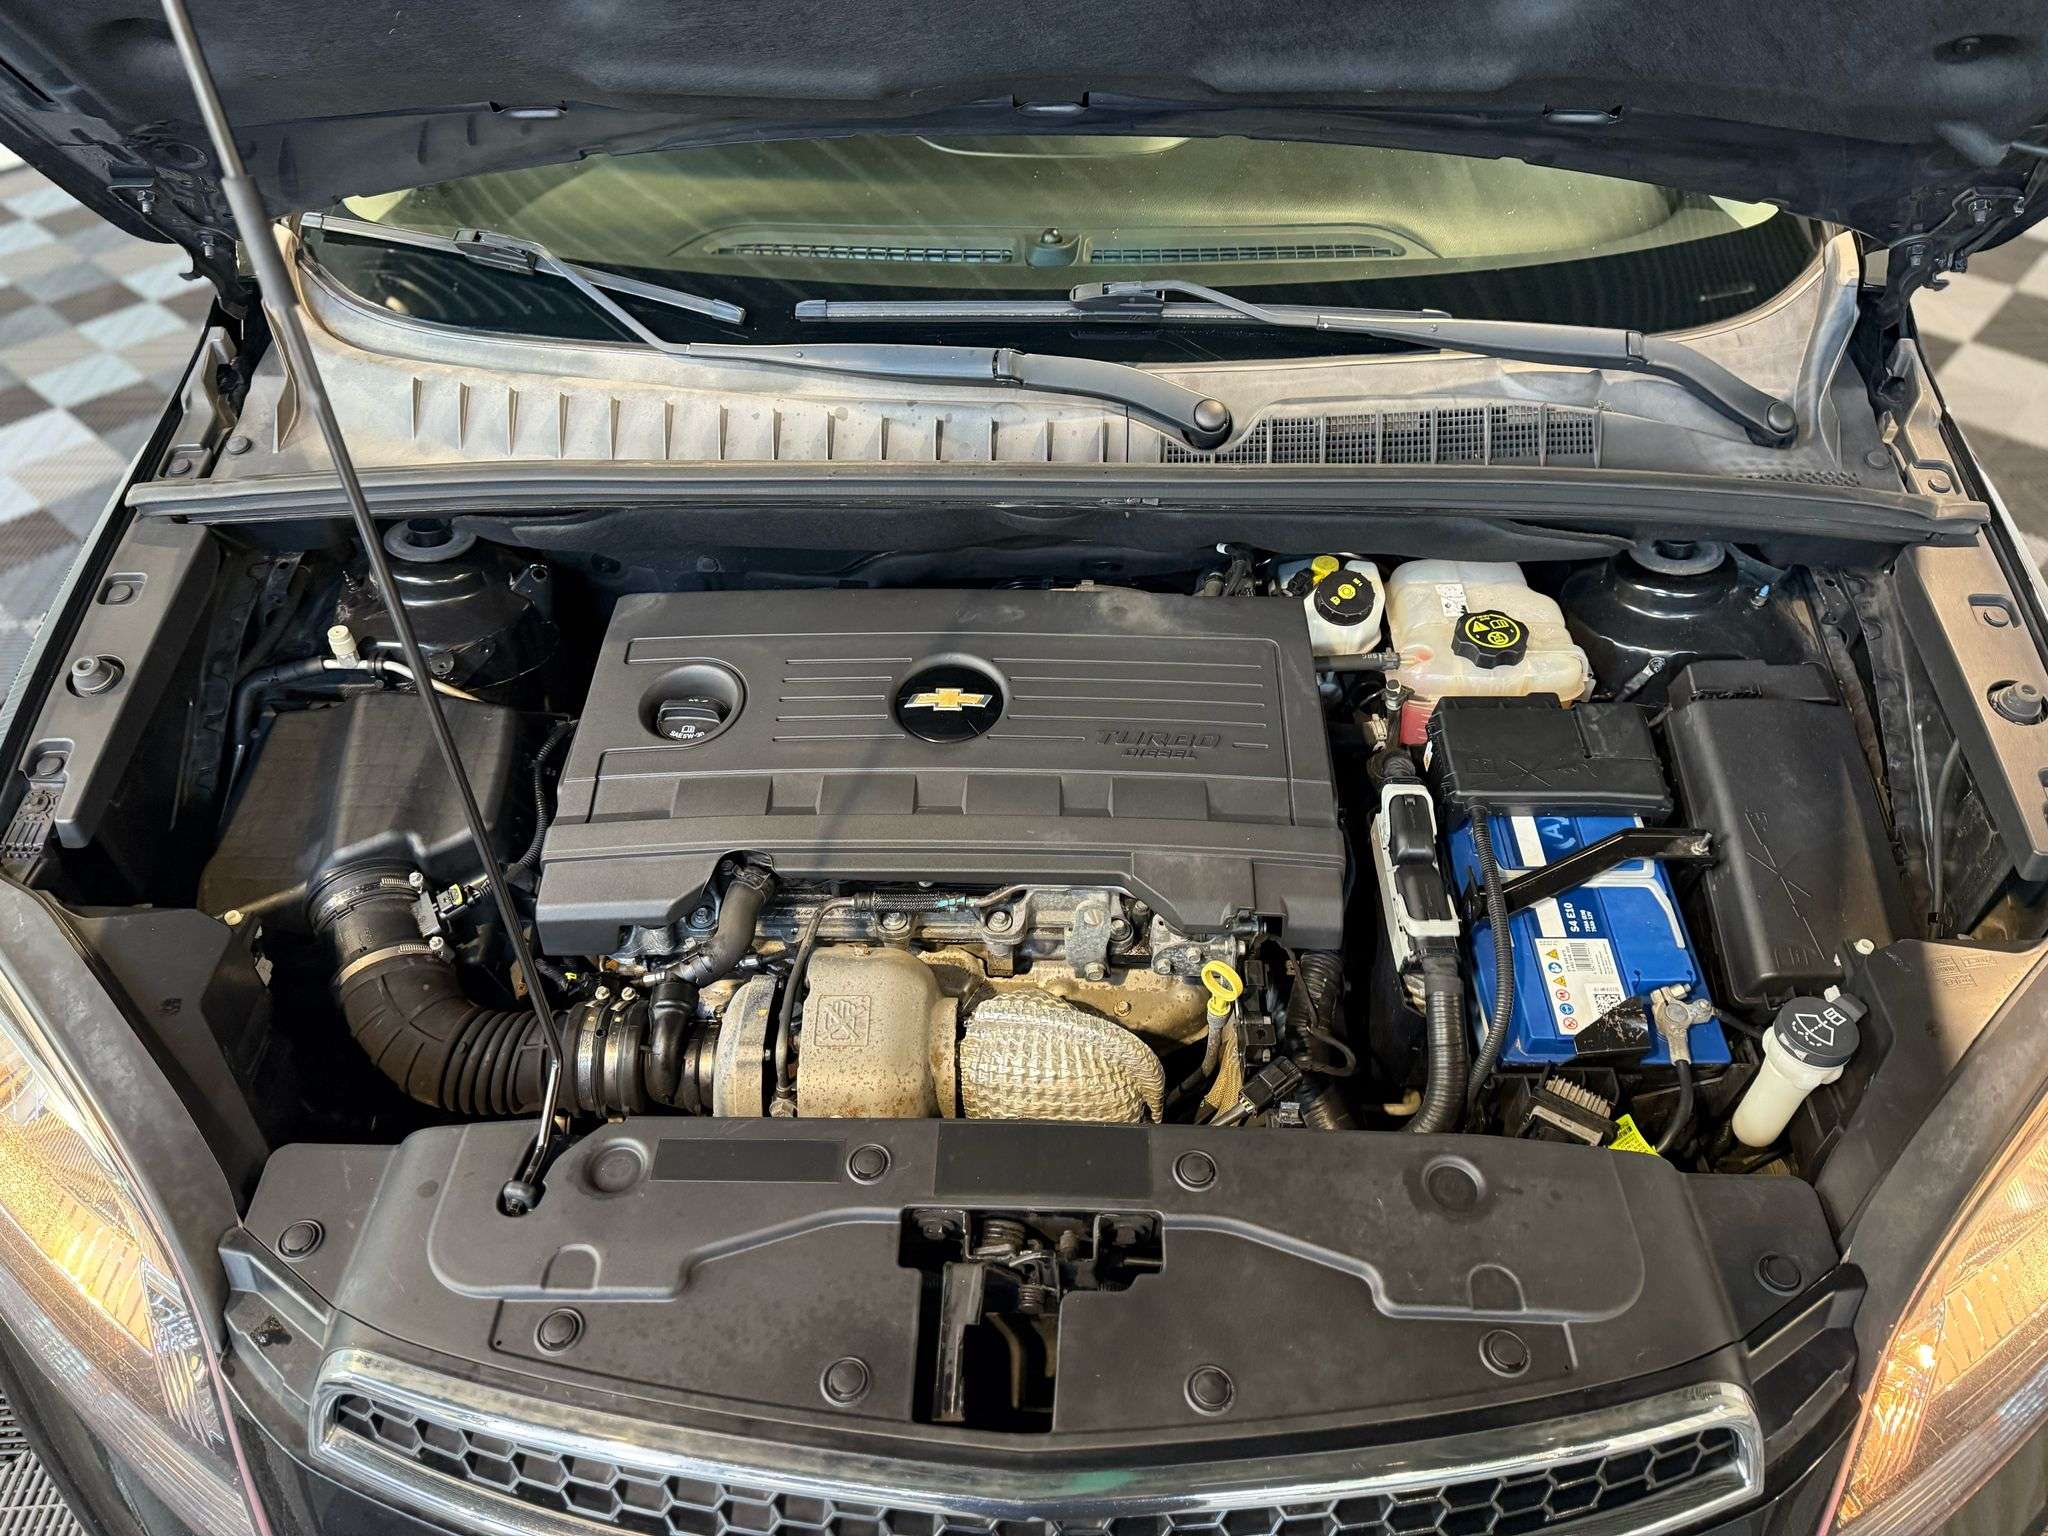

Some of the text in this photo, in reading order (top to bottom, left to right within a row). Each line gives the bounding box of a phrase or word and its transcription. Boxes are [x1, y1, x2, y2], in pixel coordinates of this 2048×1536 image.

[1096, 730, 1222, 748] TURBO
[1121, 748, 1198, 760] DIESEL
[1563, 902, 1576, 919] E10
[1568, 920, 1580, 933] S4
